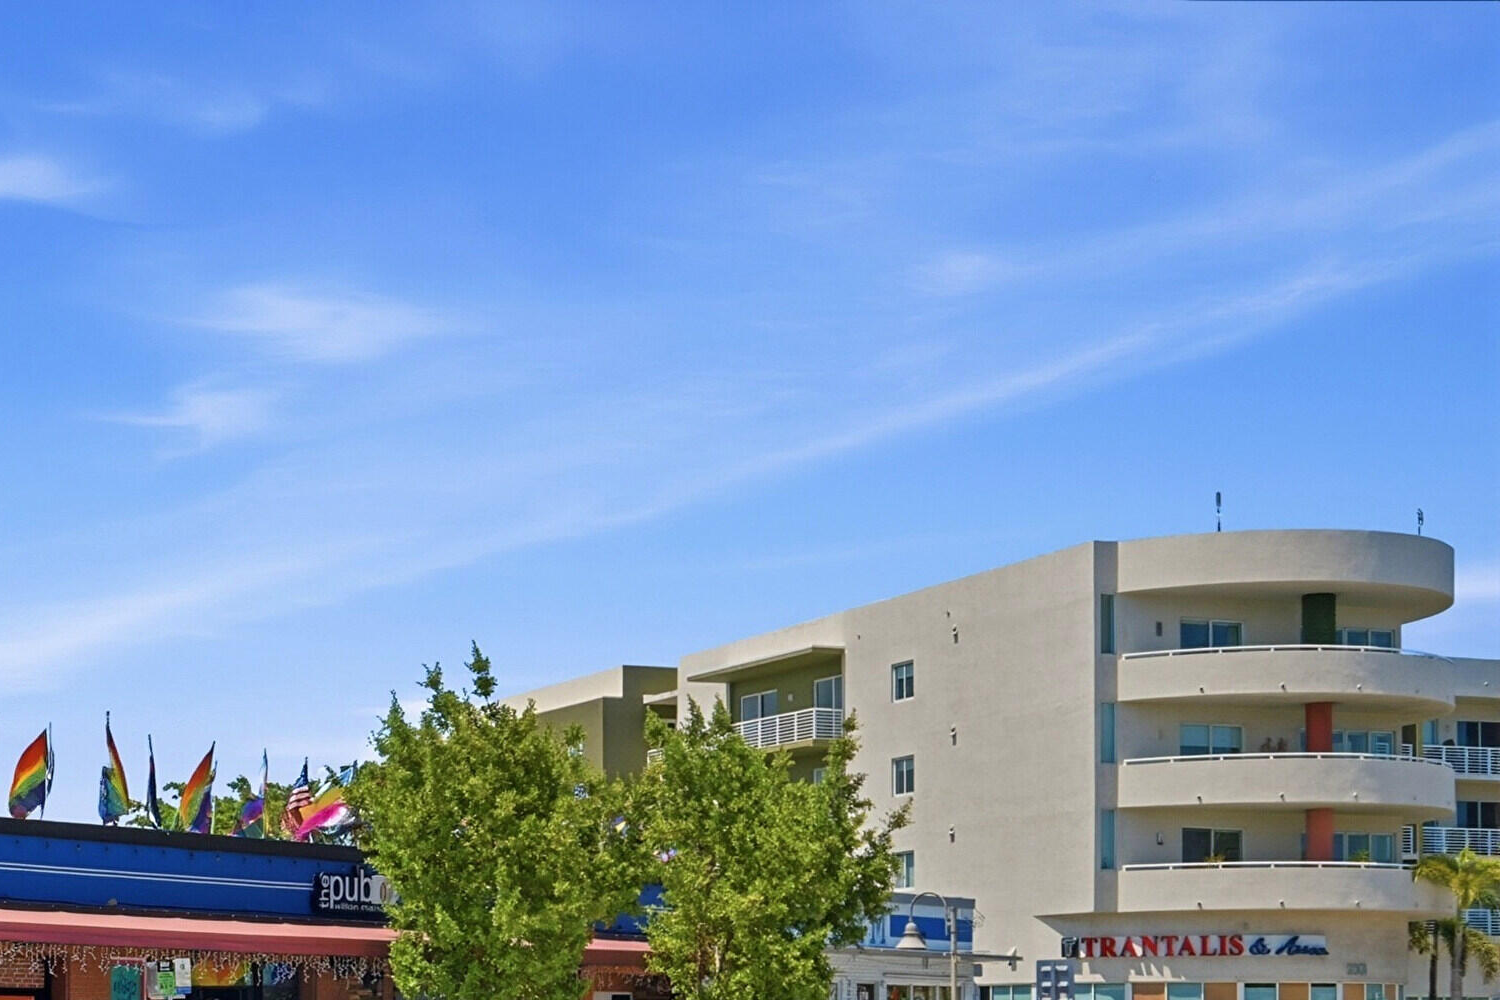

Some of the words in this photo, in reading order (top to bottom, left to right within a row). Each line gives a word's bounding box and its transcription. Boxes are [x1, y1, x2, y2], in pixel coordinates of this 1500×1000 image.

[319, 874, 330, 908] the
[329, 868, 372, 910] pub
[1081, 933, 1244, 957] TRANTALIS
[1249, 937, 1271, 955] &
